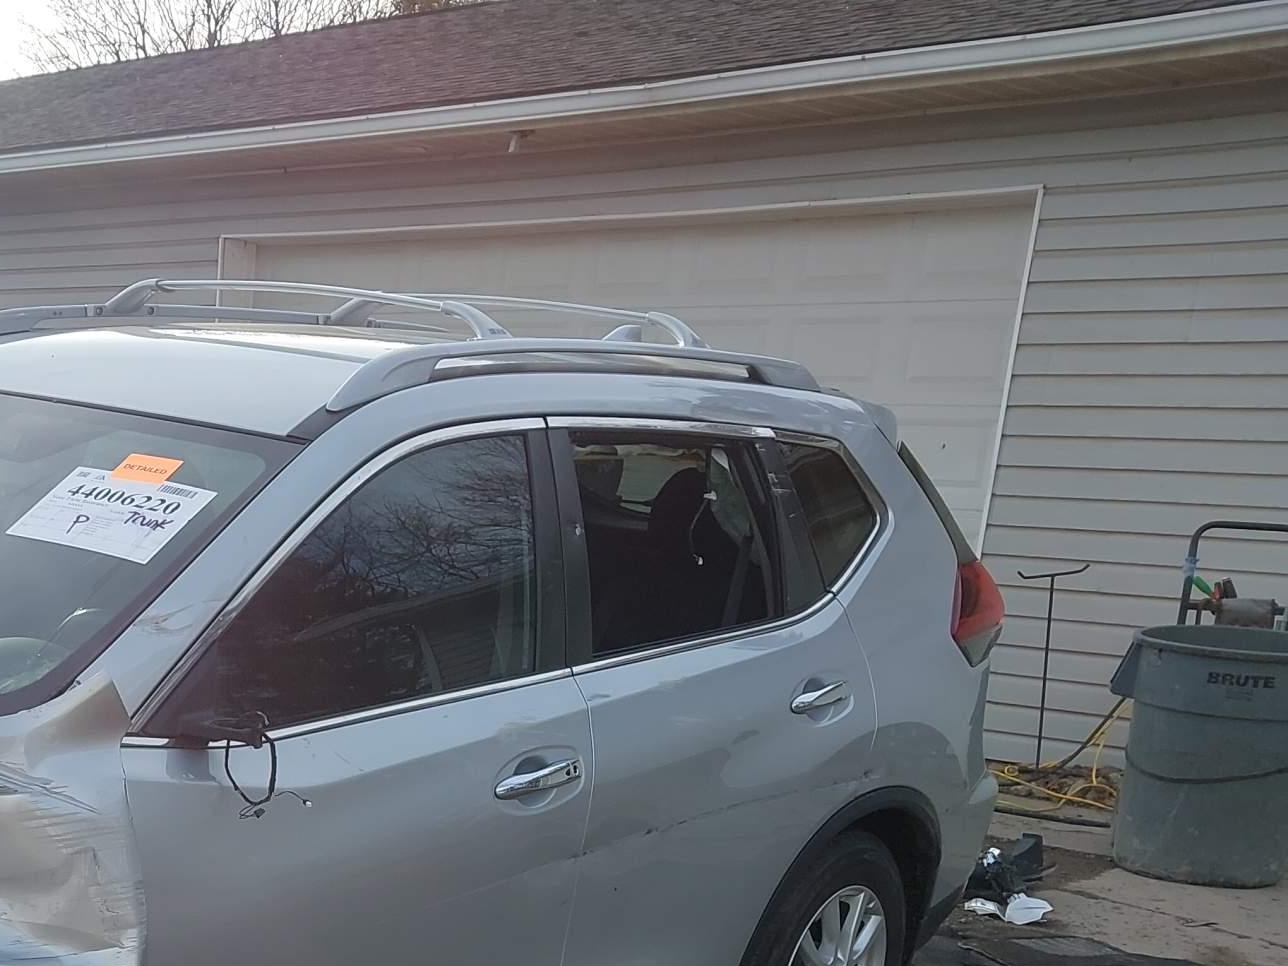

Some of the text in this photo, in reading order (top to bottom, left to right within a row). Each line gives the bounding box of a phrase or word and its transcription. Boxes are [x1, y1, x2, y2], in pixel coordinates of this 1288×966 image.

[123, 463, 168, 475] DETAILED
[67, 484, 181, 515] 44006220
[65, 514, 90, 534] P
[1207, 672, 1276, 689] BRUTE
